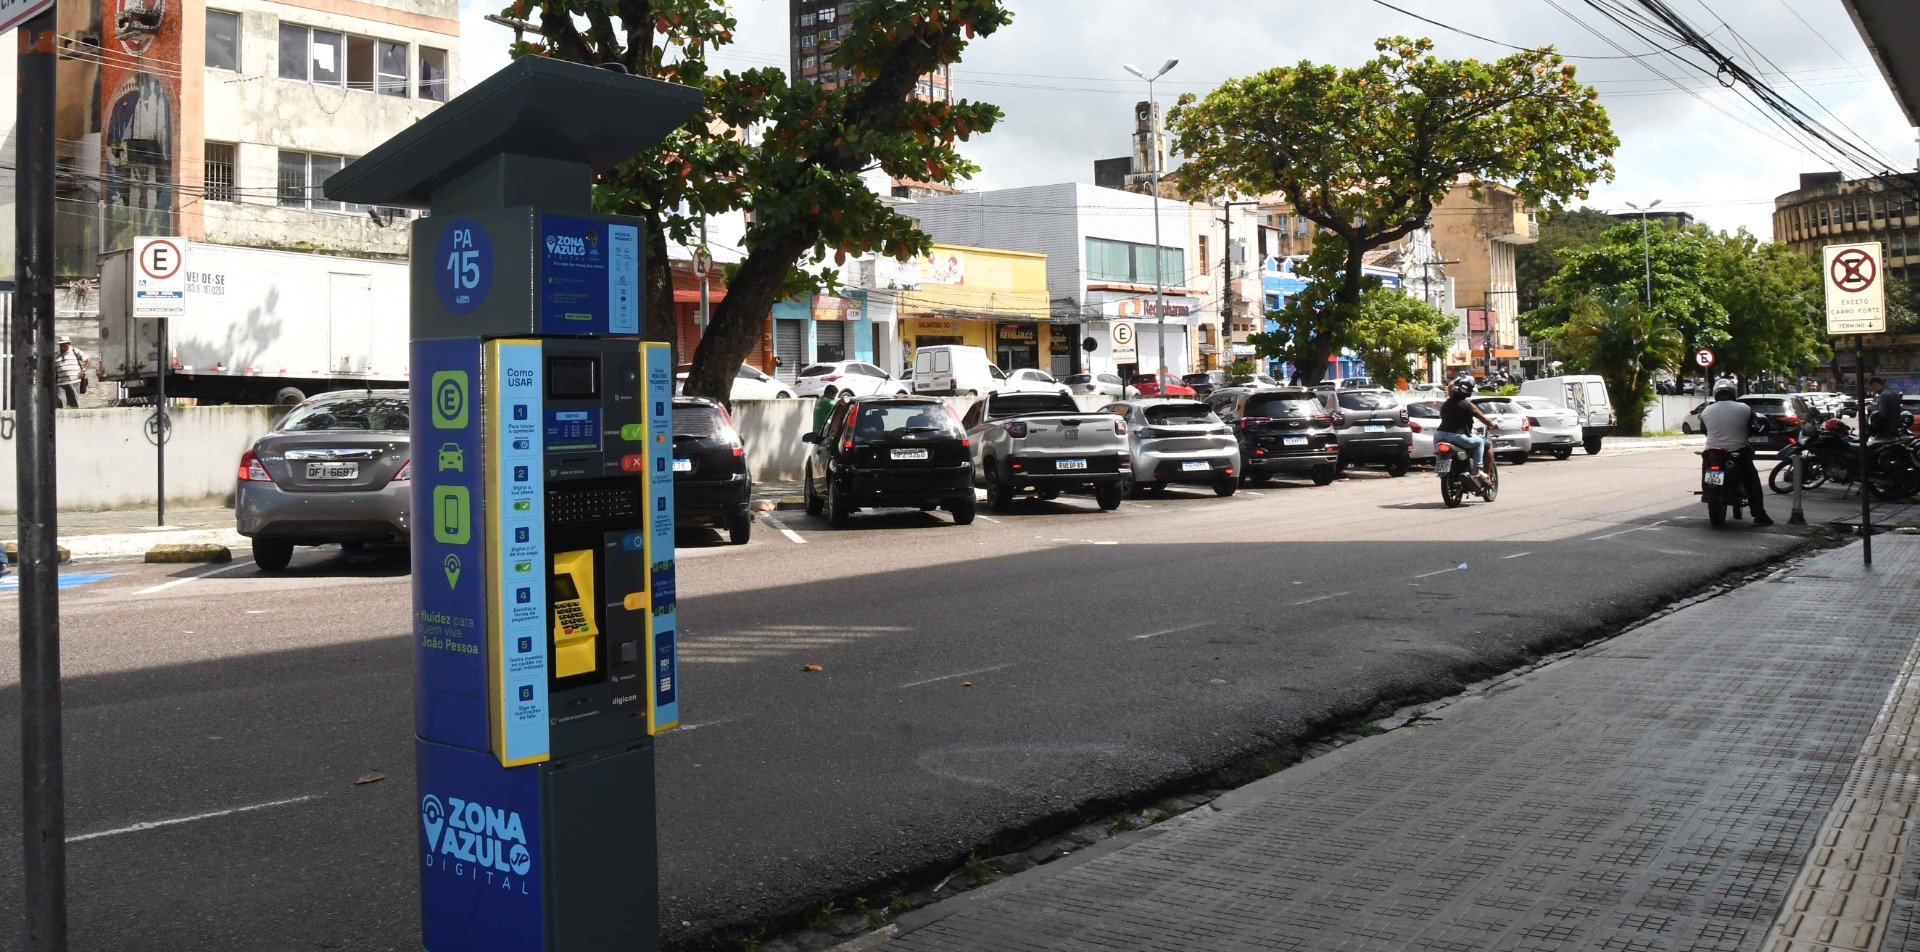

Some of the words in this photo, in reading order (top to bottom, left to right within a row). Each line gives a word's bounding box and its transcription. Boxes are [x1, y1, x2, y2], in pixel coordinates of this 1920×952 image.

[454, 229, 472, 249] PA
[557, 236, 584, 247] ZONA
[554, 246, 580, 256] AZUL
[153, 249, 167, 271] E
[446, 250, 480, 289] 15
[1120, 328, 1126, 339] E
[507, 368, 533, 377] Como
[445, 389, 455, 410] E
[518, 408, 523, 416] 1
[518, 470, 524, 479] 2
[519, 531, 525, 539] 3
[520, 591, 526, 599] 4
[421, 610, 450, 624] fluidez
[454, 616, 474, 628] para
[444, 626, 462, 638] vive
[422, 636, 443, 649] João
[446, 638, 478, 654] Pessoa
[522, 640, 528, 649] 5
[523, 688, 529, 697] 6
[612, 695, 636, 705] digicon
[449, 797, 526, 845] ZONA
[441, 827, 510, 872] AZUL
[426, 854, 528, 894] DIGITAL
